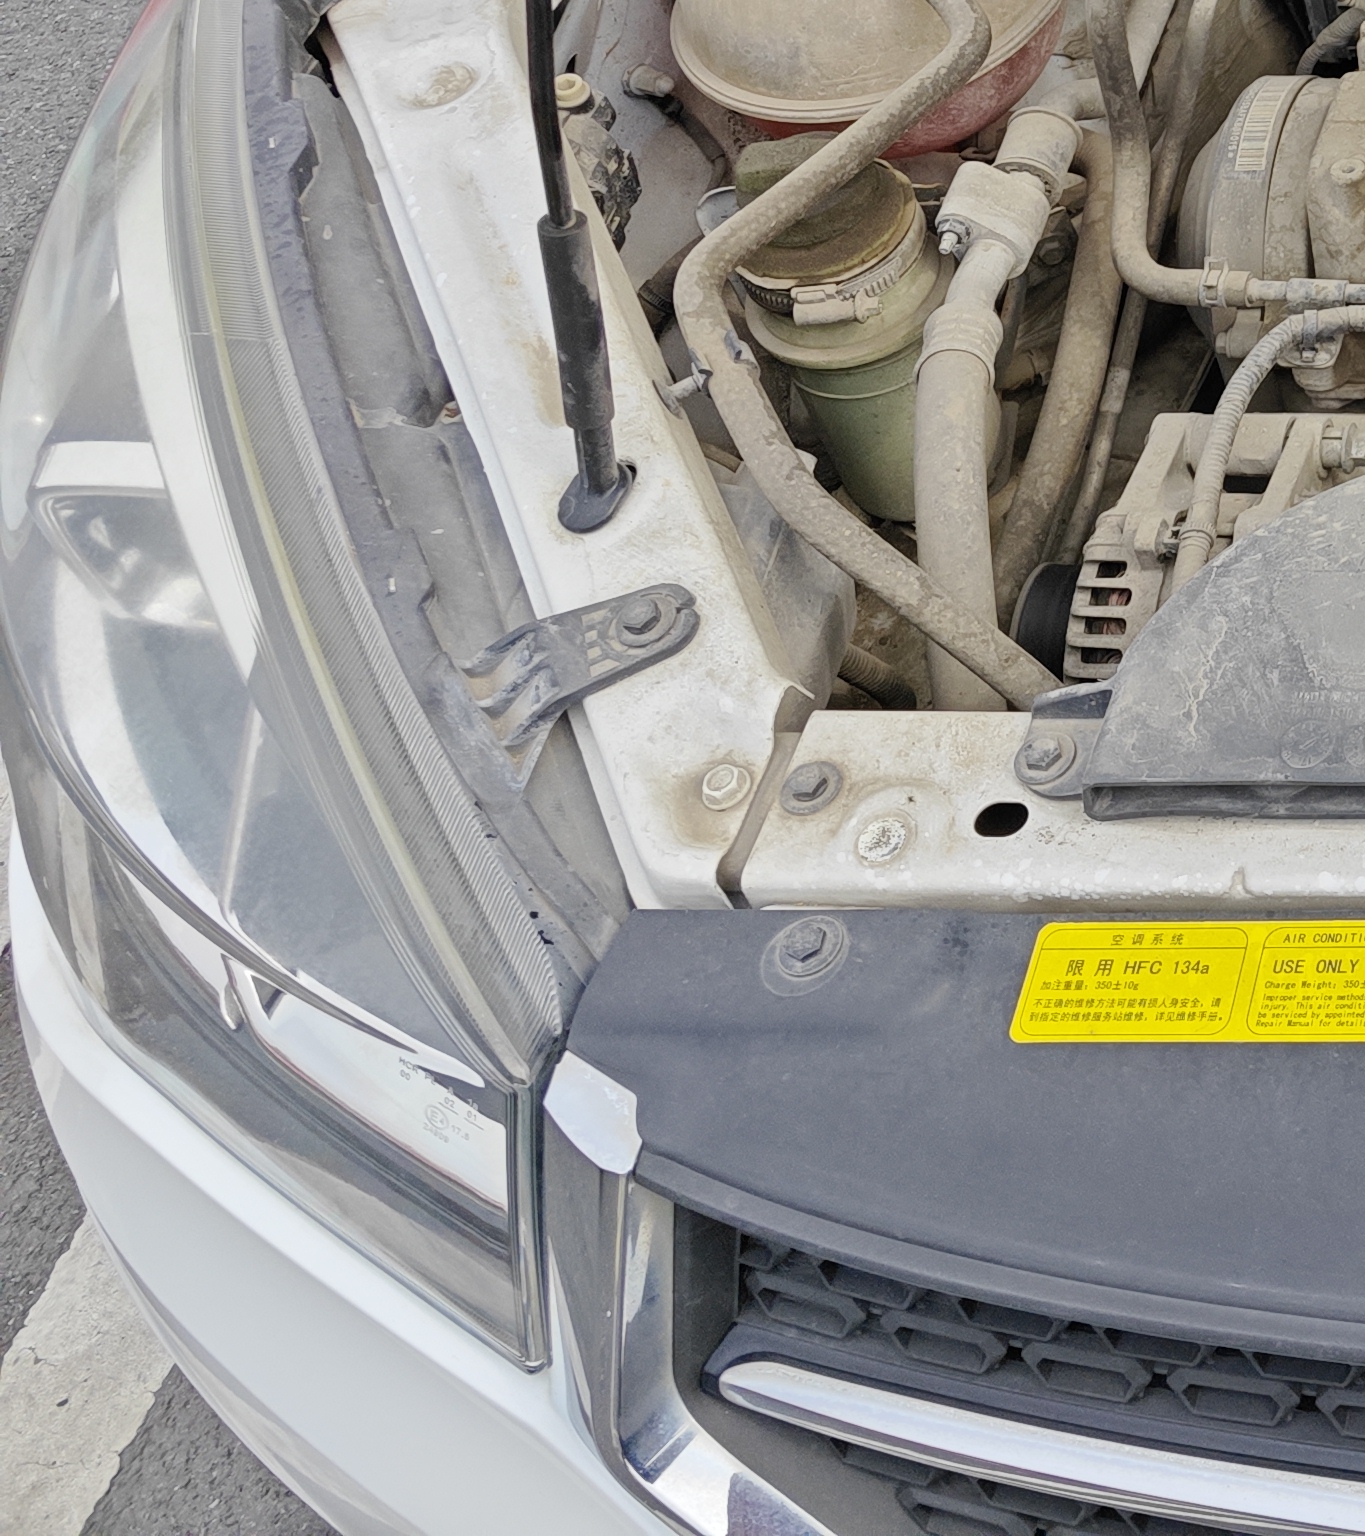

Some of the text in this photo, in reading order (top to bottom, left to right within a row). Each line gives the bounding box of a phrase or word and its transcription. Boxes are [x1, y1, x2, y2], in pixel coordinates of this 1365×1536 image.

[1111, 933, 1185, 946] 空调系统
[1283, 933, 1307, 943] AIR
[1065, 959, 1210, 977] 限用 HFC 134a
[1273, 960, 1306, 974] USE
[1316, 959, 1359, 974] ONLY
[1265, 981, 1296, 990] Charge
[1262, 994, 1297, 1002] Improper
[1302, 993, 1333, 1001] service
[1261, 1003, 1290, 1011] injury.
[1296, 1002, 1314, 1010] This
[1318, 1002, 1331, 1010] air
[1311, 1011, 1321, 1019] by
[1325, 1011, 1365, 1019] appointed
[1256, 1020, 1283, 1028] Repair
